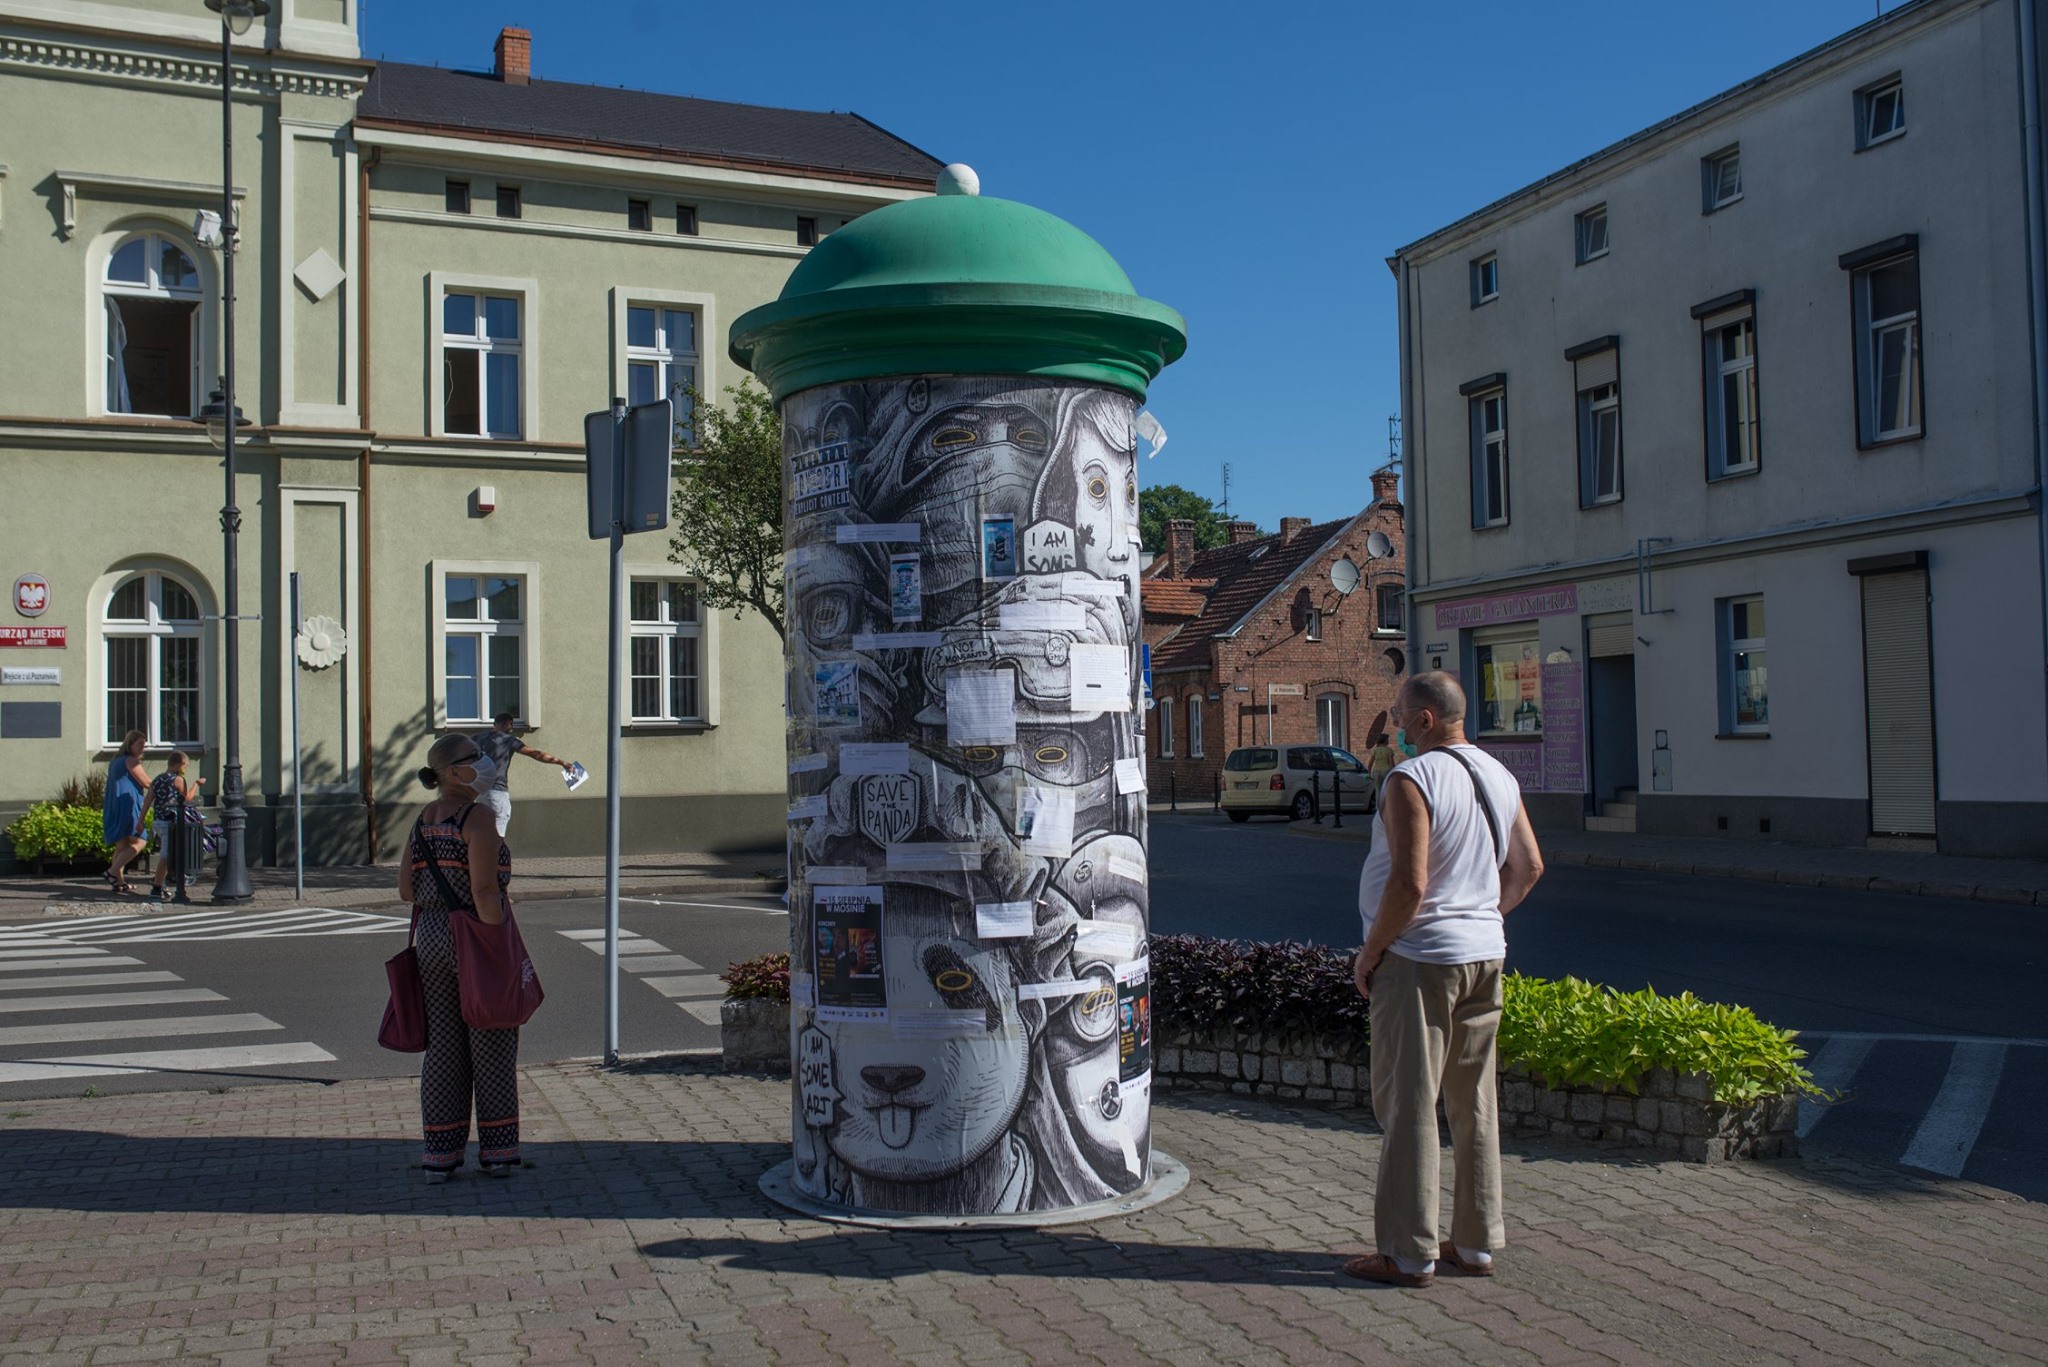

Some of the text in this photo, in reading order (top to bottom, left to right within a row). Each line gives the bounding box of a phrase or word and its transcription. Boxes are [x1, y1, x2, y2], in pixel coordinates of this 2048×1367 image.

[1043, 530, 1067, 548] AM
[1437, 590, 1575, 625] OBUWIE GALANTERIA
[30, 628, 65, 639] MIEJSKI
[953, 641, 974, 652] NO!
[945, 651, 988, 663] MONSANTO
[1047, 653, 1064, 662] GMO
[867, 780, 909, 802] SAVE
[868, 809, 911, 843] PANDA
[825, 904, 866, 913] W MOSINIE
[828, 896, 872, 904] 15 SIERPNIA
[811, 1036, 823, 1055] AM
[801, 1057, 830, 1088] SOME
[806, 1093, 831, 1115] ART
